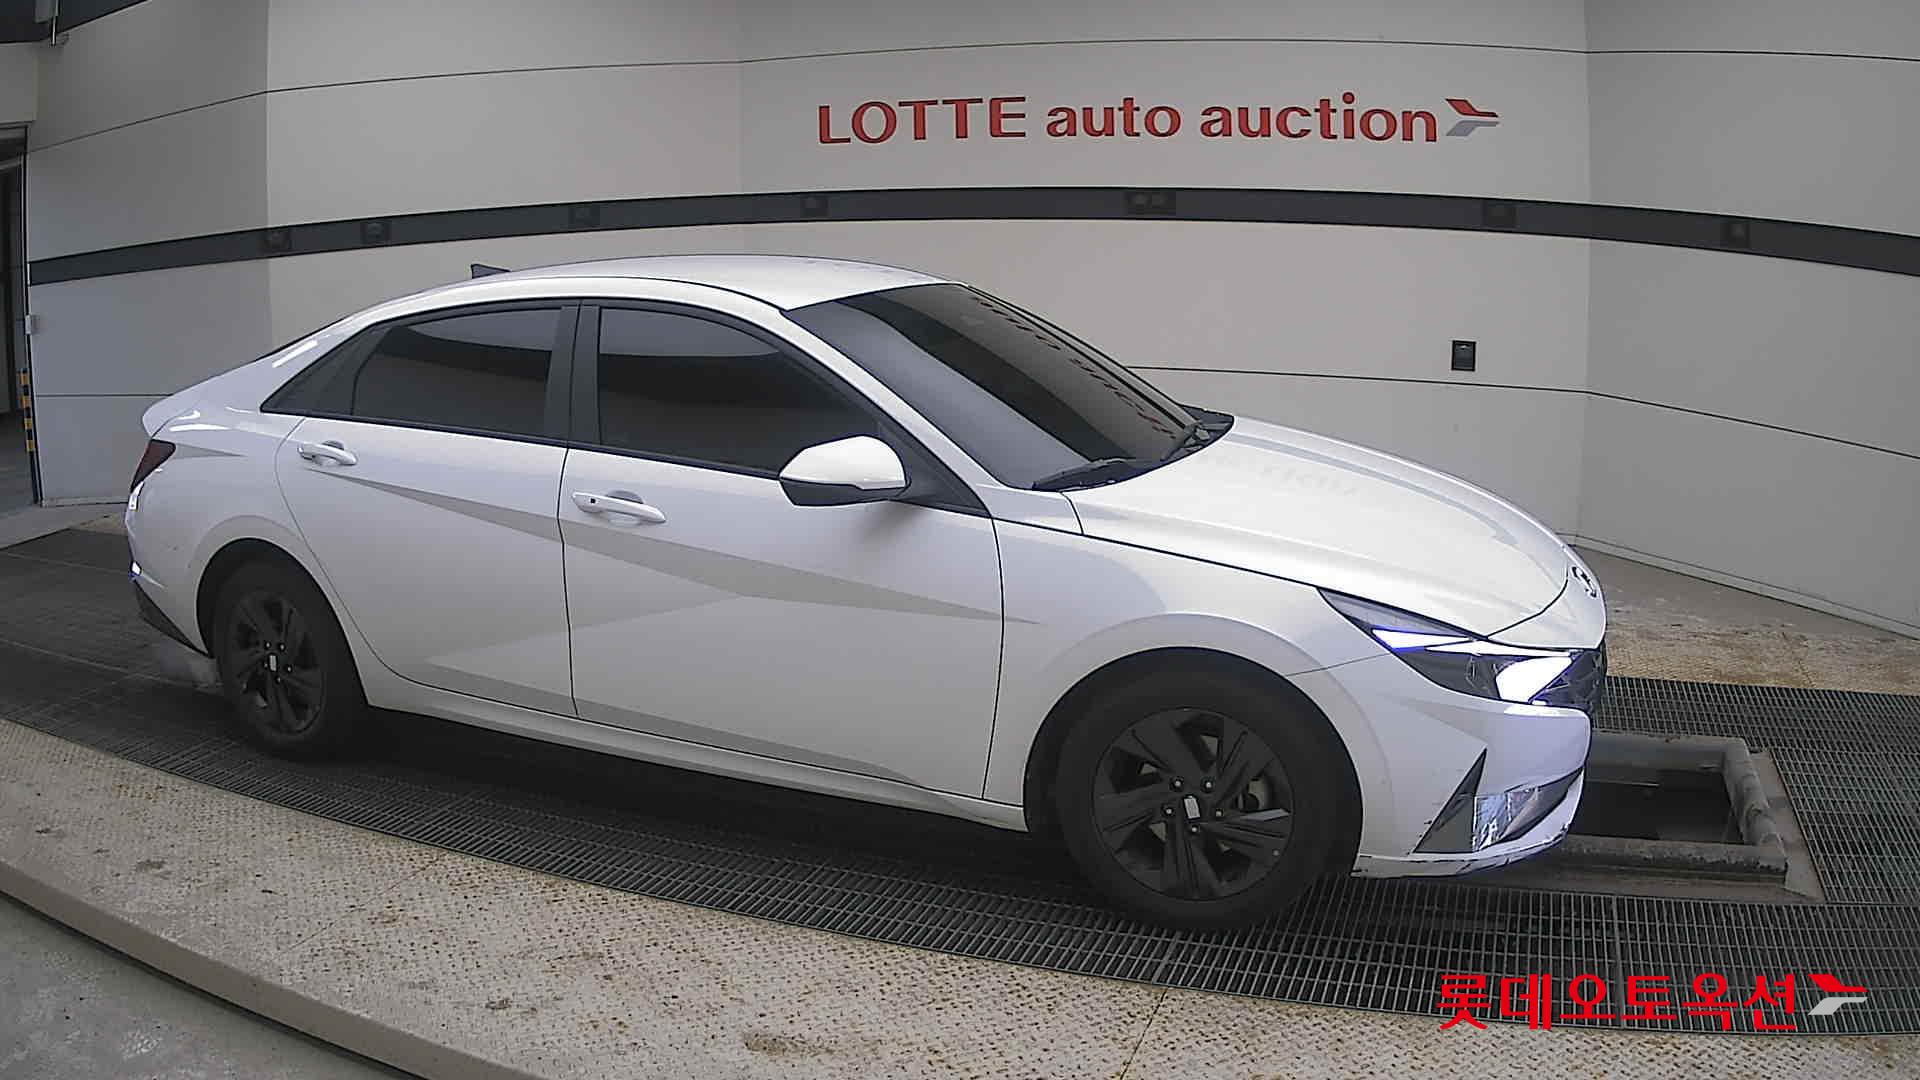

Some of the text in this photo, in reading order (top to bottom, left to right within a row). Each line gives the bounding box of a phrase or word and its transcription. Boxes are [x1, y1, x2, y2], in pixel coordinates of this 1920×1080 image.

[818, 92, 1438, 144] LOTTE auto auction
